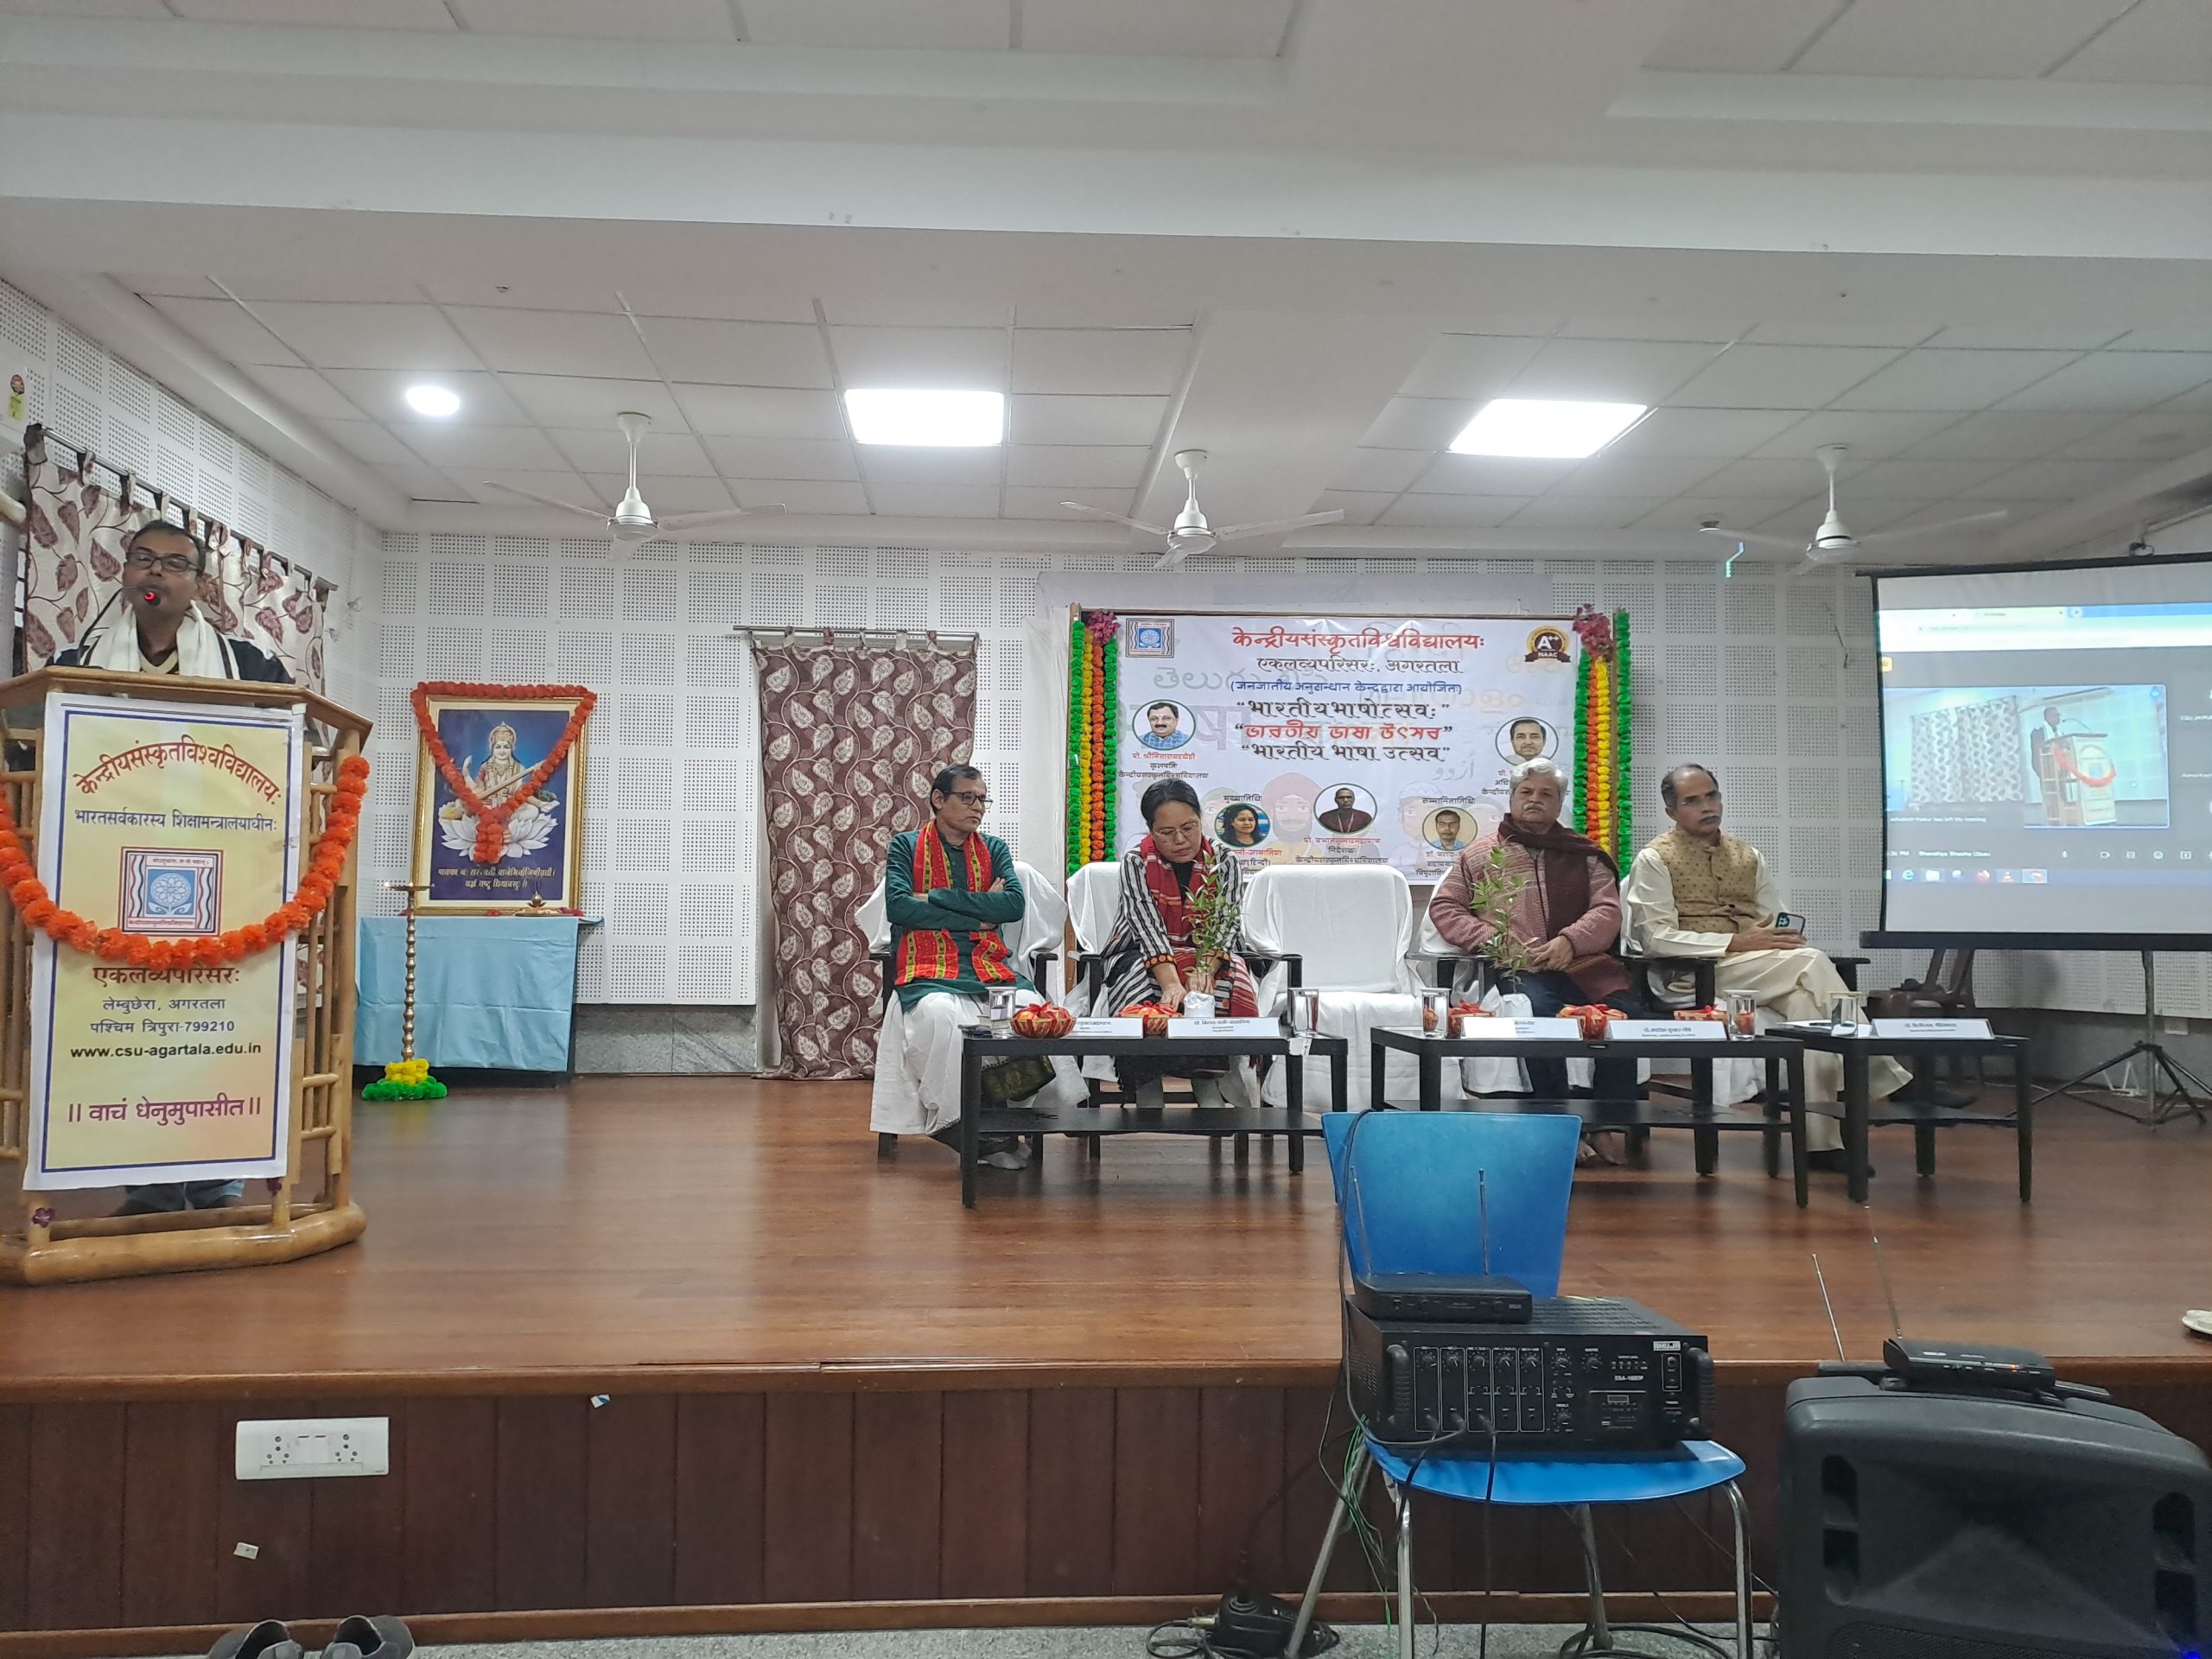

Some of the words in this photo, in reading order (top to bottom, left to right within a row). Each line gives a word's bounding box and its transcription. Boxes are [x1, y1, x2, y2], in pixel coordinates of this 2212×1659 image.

[1385, 659, 1464, 673] अगरतला
[1332, 745, 1378, 760] भाषा
[73, 734, 282, 805] केन्द्रीयसंस्कृतविश्वविद्यालयः
[168, 999, 226, 1010] अगरतला
[90, 1019, 135, 1033] पश्चिम
[142, 1019, 235, 1036] त्रिपुरा-799210
[70, 1042, 262, 1059] www.csu-agartala.edu.in
[89, 1097, 128, 1122] वाचं
